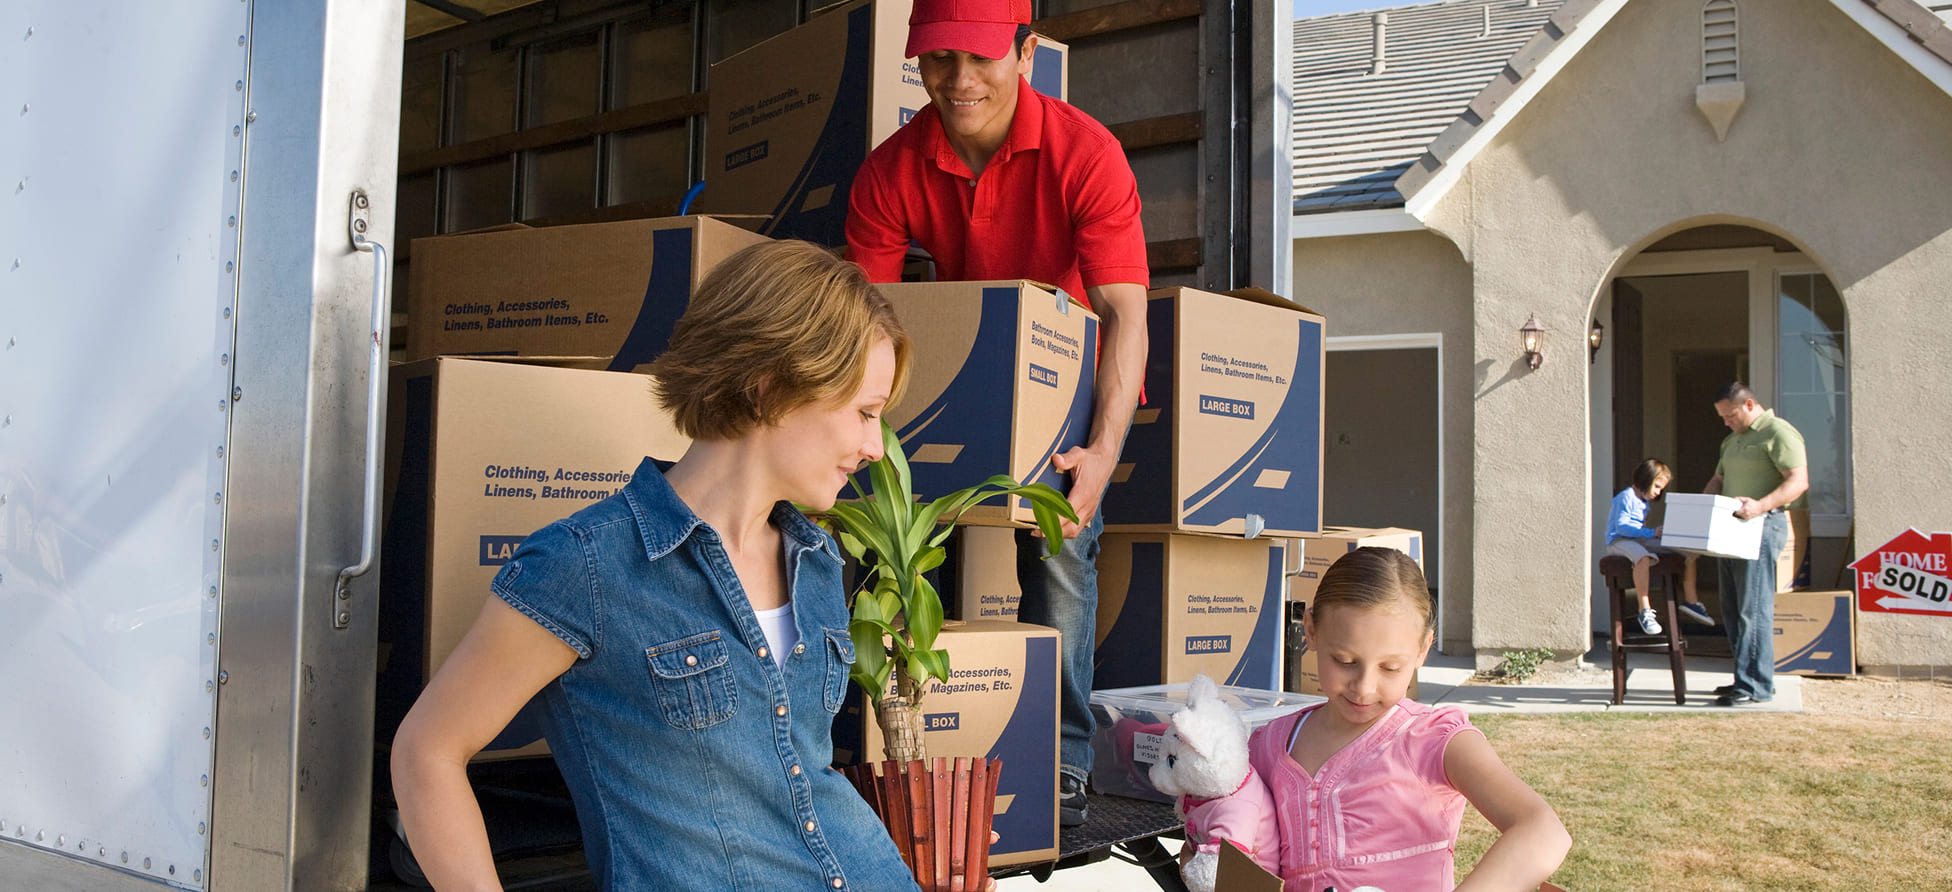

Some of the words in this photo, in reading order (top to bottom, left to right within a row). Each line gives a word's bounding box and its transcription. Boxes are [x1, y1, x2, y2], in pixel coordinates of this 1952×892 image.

[750, 144, 765, 158] BOX
[444, 302, 493, 315] Clothing,
[497, 298, 570, 312] Accessories,
[444, 319, 483, 331] Linens,
[487, 316, 542, 329] Bathroom
[545, 314, 581, 326] Items,
[585, 312, 609, 324] Etc.
[1032, 320, 1053, 338] Bathroom
[1053, 330, 1079, 350] Accessories,
[1031, 334, 1046, 350] Books,
[1047, 340, 1070, 359] Magazines,
[1201, 352, 1229, 366] Clothing,
[1230, 357, 1268, 372] Accessories,
[1030, 367, 1046, 382] SMALL
[1046, 373, 1057, 385] BOX
[1201, 363, 1224, 376] Linens,
[1225, 367, 1254, 380] Bathroom
[1255, 372, 1274, 384] Items,
[1275, 375, 1287, 385] Etc.
[1202, 399, 1231, 413] LARGE
[1232, 403, 1250, 416] BOX
[485, 465, 550, 482] Clothing,
[485, 484, 537, 500] Linens,
[541, 486, 610, 500] Bathroom
[1879, 551, 1947, 571] HOME
[1882, 567, 1948, 603] SOLD
[981, 594, 1004, 605] Clothing,
[1188, 594, 1211, 604] Clothing,
[1187, 606, 1206, 615] Linens,
[1208, 606, 1232, 614] Bathroom
[1249, 605, 1258, 613] Etc.
[1188, 640, 1212, 651] LARGE
[1213, 639, 1228, 650] BOX
[948, 667, 1012, 680] Accessories,
[930, 682, 989, 695] Magazines,
[992, 680, 1013, 690] Etc.
[932, 717, 956, 728] BOX
